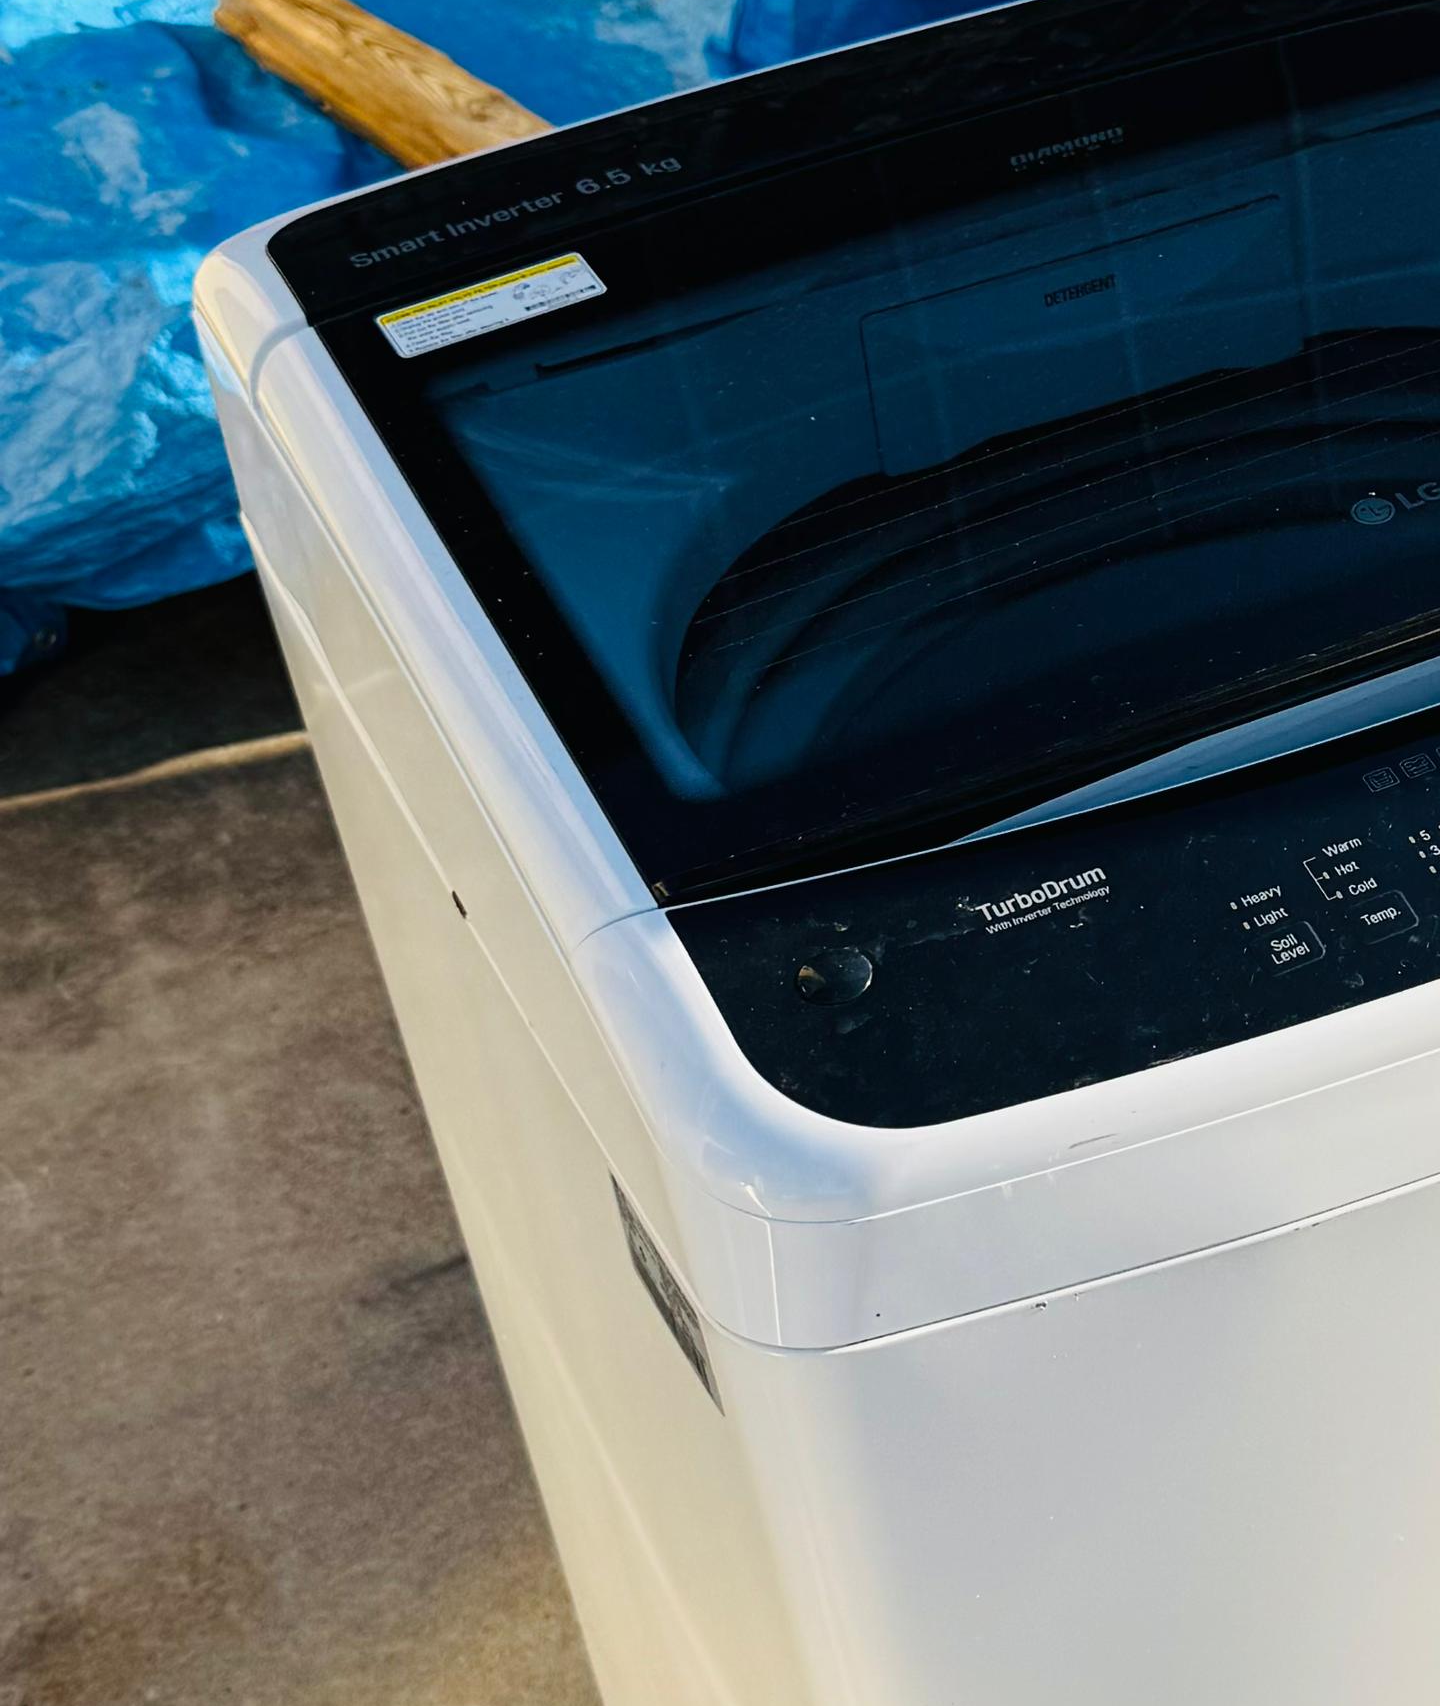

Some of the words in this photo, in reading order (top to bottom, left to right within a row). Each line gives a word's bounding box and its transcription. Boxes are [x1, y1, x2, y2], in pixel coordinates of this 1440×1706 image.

[350, 229, 446, 269] Smart
[447, 189, 566, 238] Inverter
[575, 168, 632, 196] 6.5
[640, 157, 682, 177] kg
[1043, 273, 1117, 308] DETERGENT
[1419, 829, 1432, 841] 5
[1321, 837, 1363, 858] Warm
[1334, 860, 1360, 877] Hot
[974, 866, 1108, 922] TurboDrum
[1240, 885, 1282, 908] Heavy
[1348, 877, 1378, 896] Cold
[985, 920, 1013, 935] With
[1012, 906, 1053, 927] Inverter
[1053, 885, 1111, 912] Technology
[1253, 907, 1289, 928] Light
[1360, 905, 1402, 927] Temp.
[1270, 933, 1298, 952] Soil
[1271, 942, 1311, 966] Level
